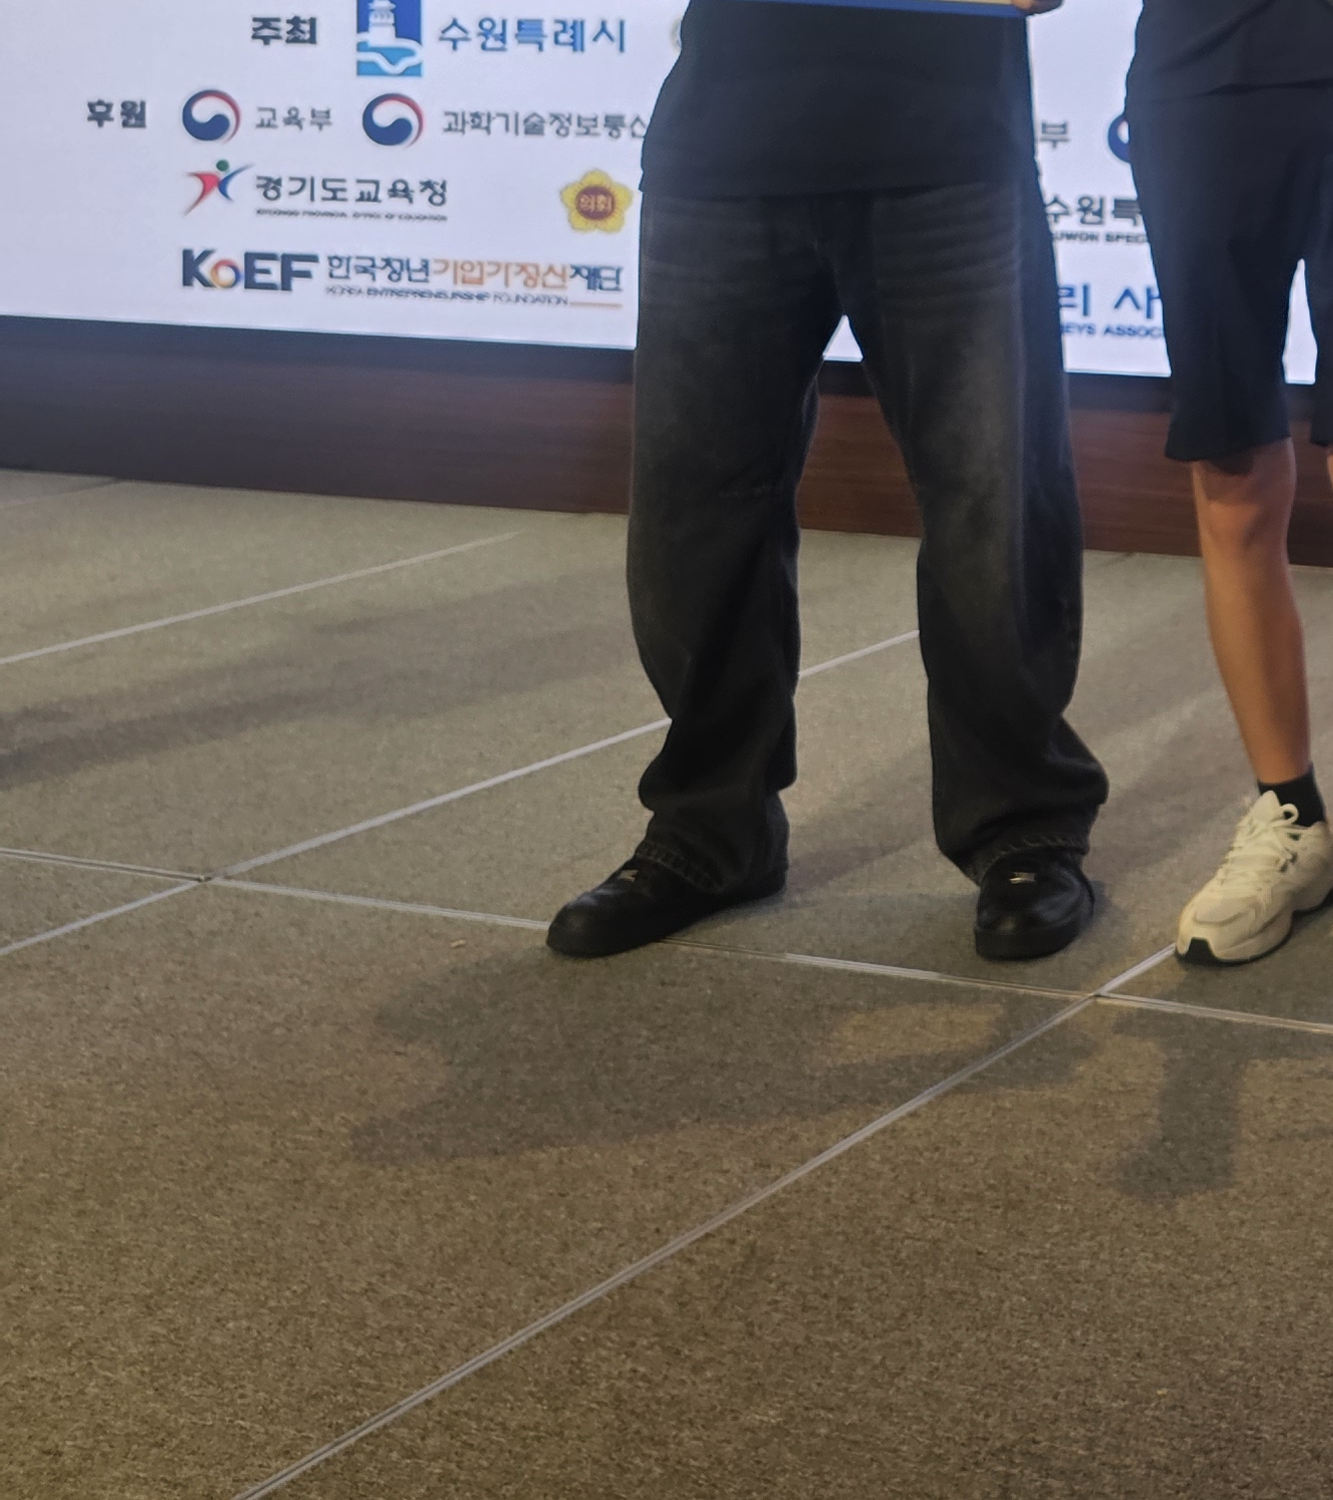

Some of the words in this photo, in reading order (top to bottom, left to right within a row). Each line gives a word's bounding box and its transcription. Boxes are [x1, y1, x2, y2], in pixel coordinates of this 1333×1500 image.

[251, 16, 318, 46] 주최
[438, 17, 627, 54] 수원특례시
[88, 100, 147, 130] 후원
[256, 106, 333, 131] 교육부
[256, 176, 449, 206] 경기도교육청
[1053, 231, 1099, 242] UWON
[182, 248, 320, 292] KoEF
[327, 253, 624, 293] 한국청년기업가정신재단
